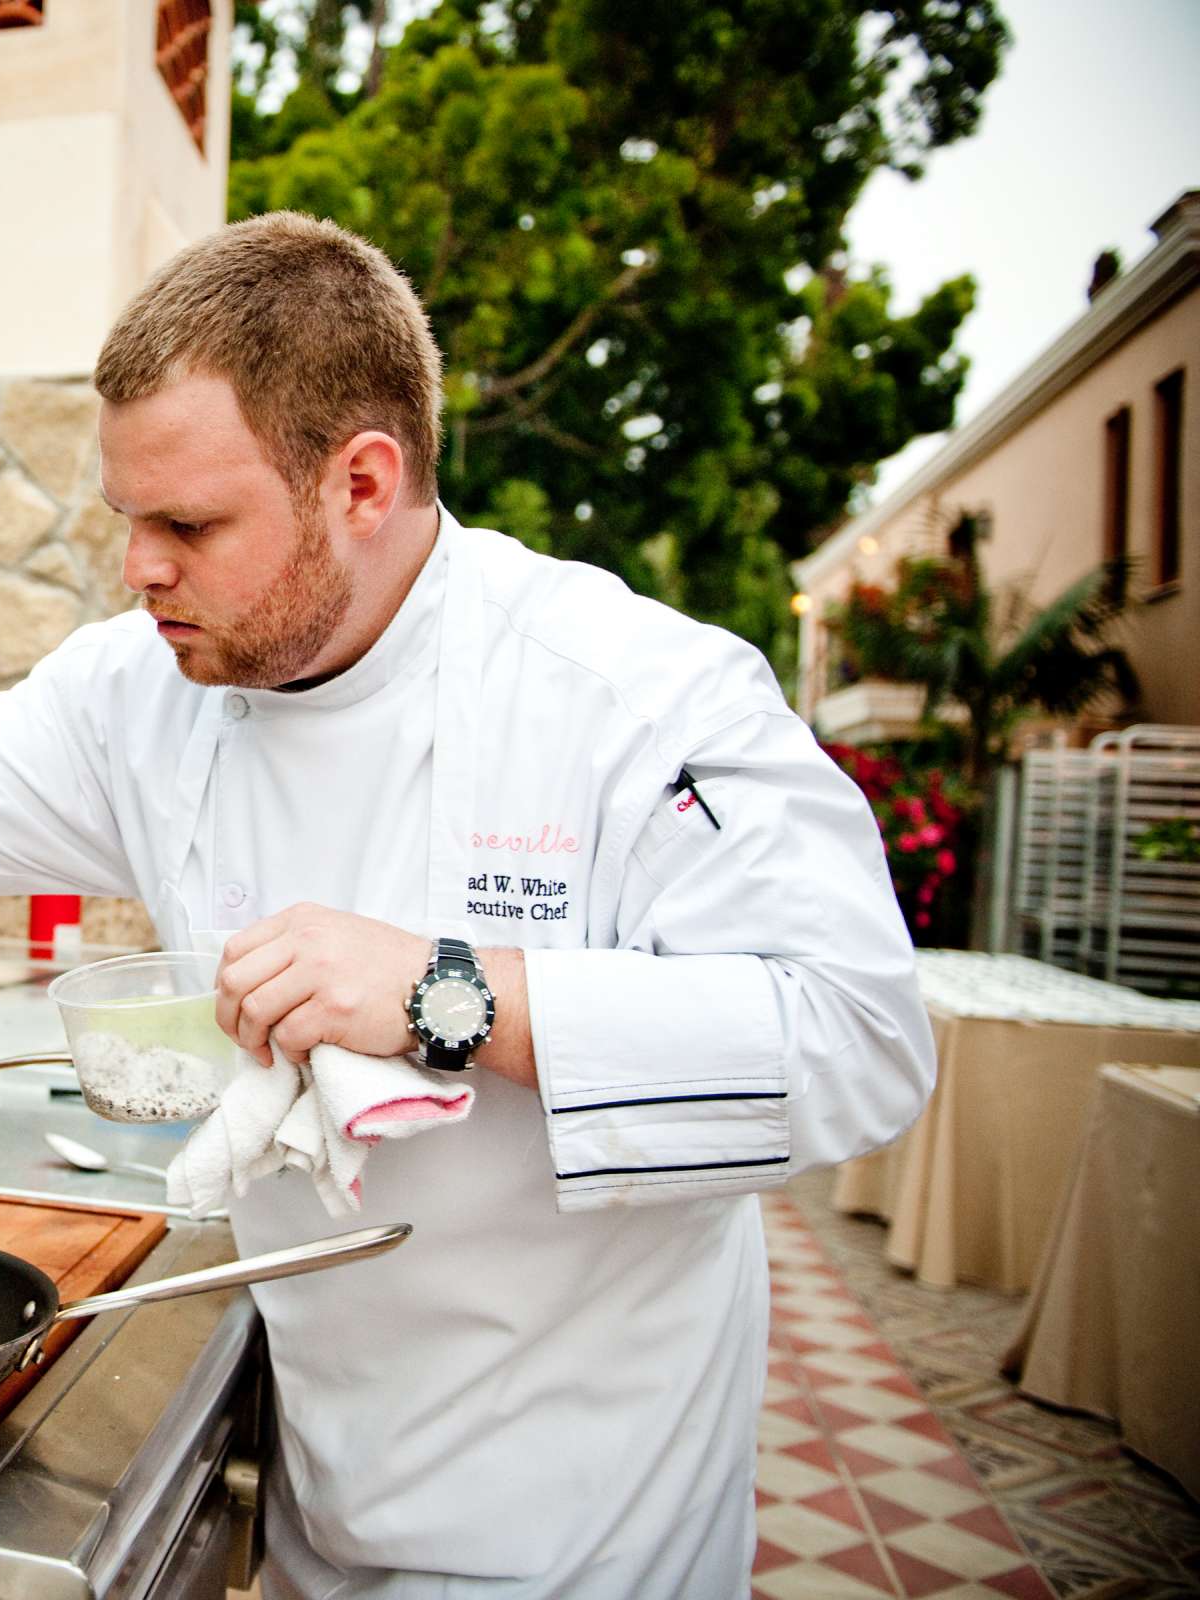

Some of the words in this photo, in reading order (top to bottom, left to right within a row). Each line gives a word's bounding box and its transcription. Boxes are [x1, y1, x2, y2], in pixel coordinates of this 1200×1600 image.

[494, 875, 514, 893] W.
[521, 878, 567, 896] White
[530, 901, 569, 920] Chef
